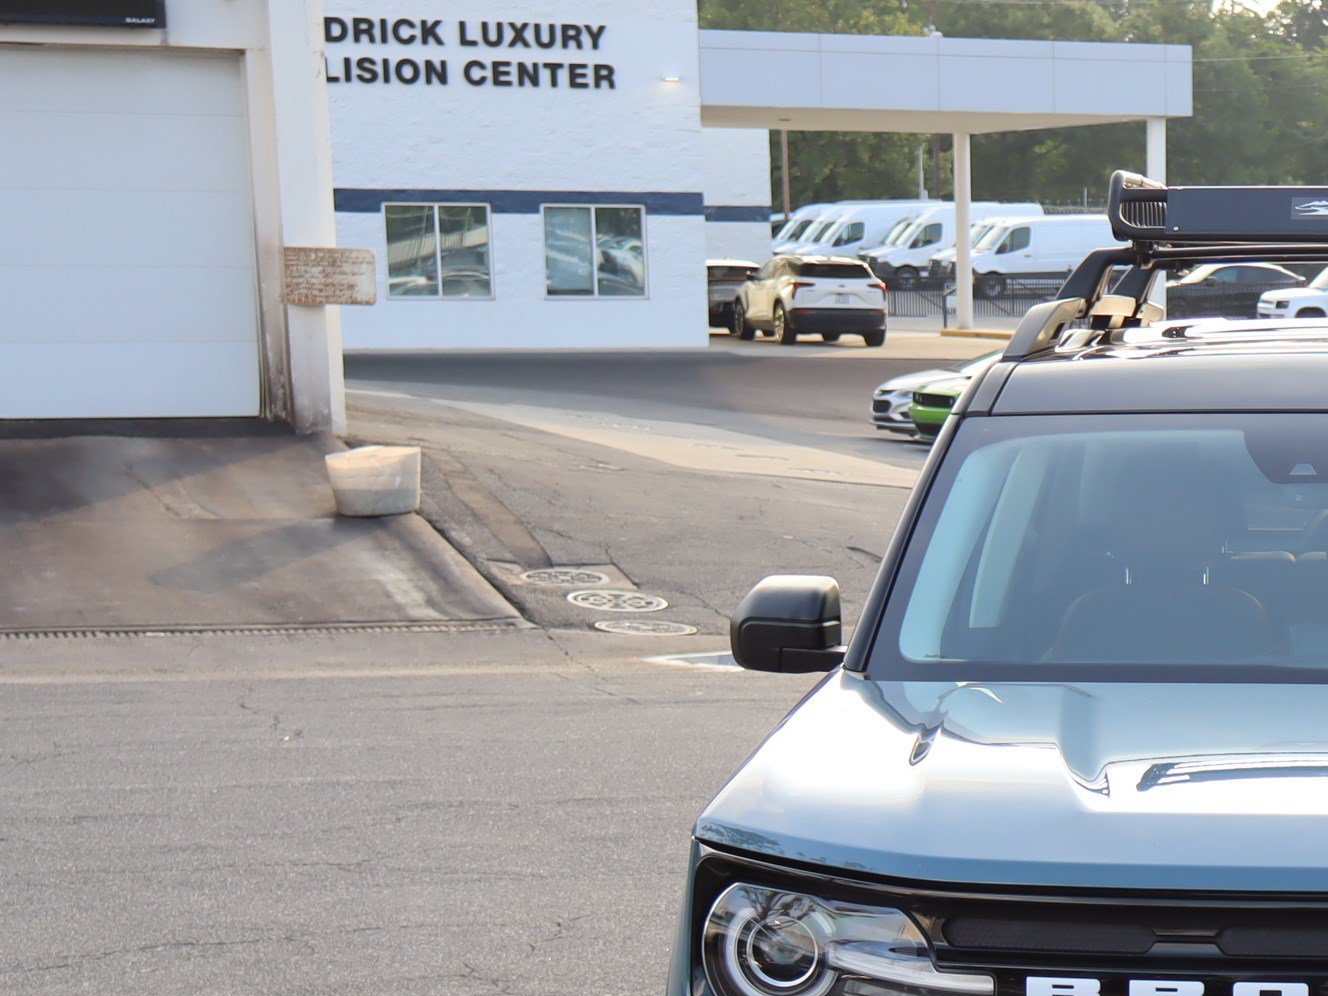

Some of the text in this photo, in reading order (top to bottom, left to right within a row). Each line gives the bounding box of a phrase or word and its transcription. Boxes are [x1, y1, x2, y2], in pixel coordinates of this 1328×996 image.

[324, 17, 606, 50] DRICK LUXURY
[463, 60, 616, 89] CENTER
